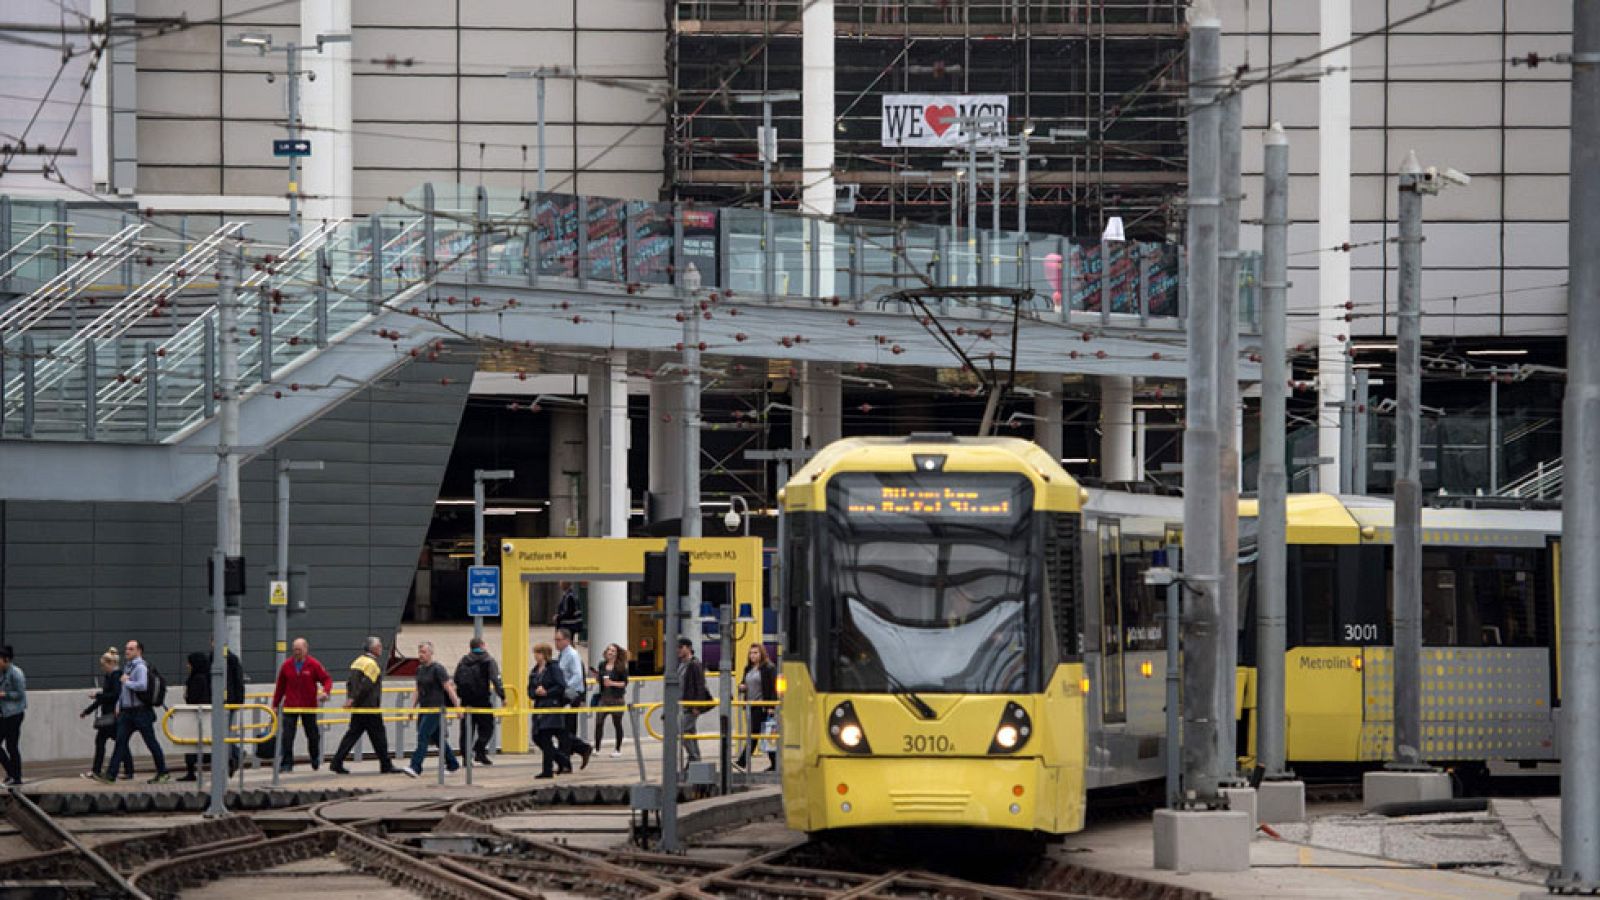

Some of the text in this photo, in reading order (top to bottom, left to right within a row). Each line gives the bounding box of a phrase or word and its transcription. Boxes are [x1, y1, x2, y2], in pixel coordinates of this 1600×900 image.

[885, 104, 923, 137] WE
[519, 551, 567, 561] Platform M4
[1344, 624, 1377, 641] 3001
[1299, 655, 1353, 670] Metrolink
